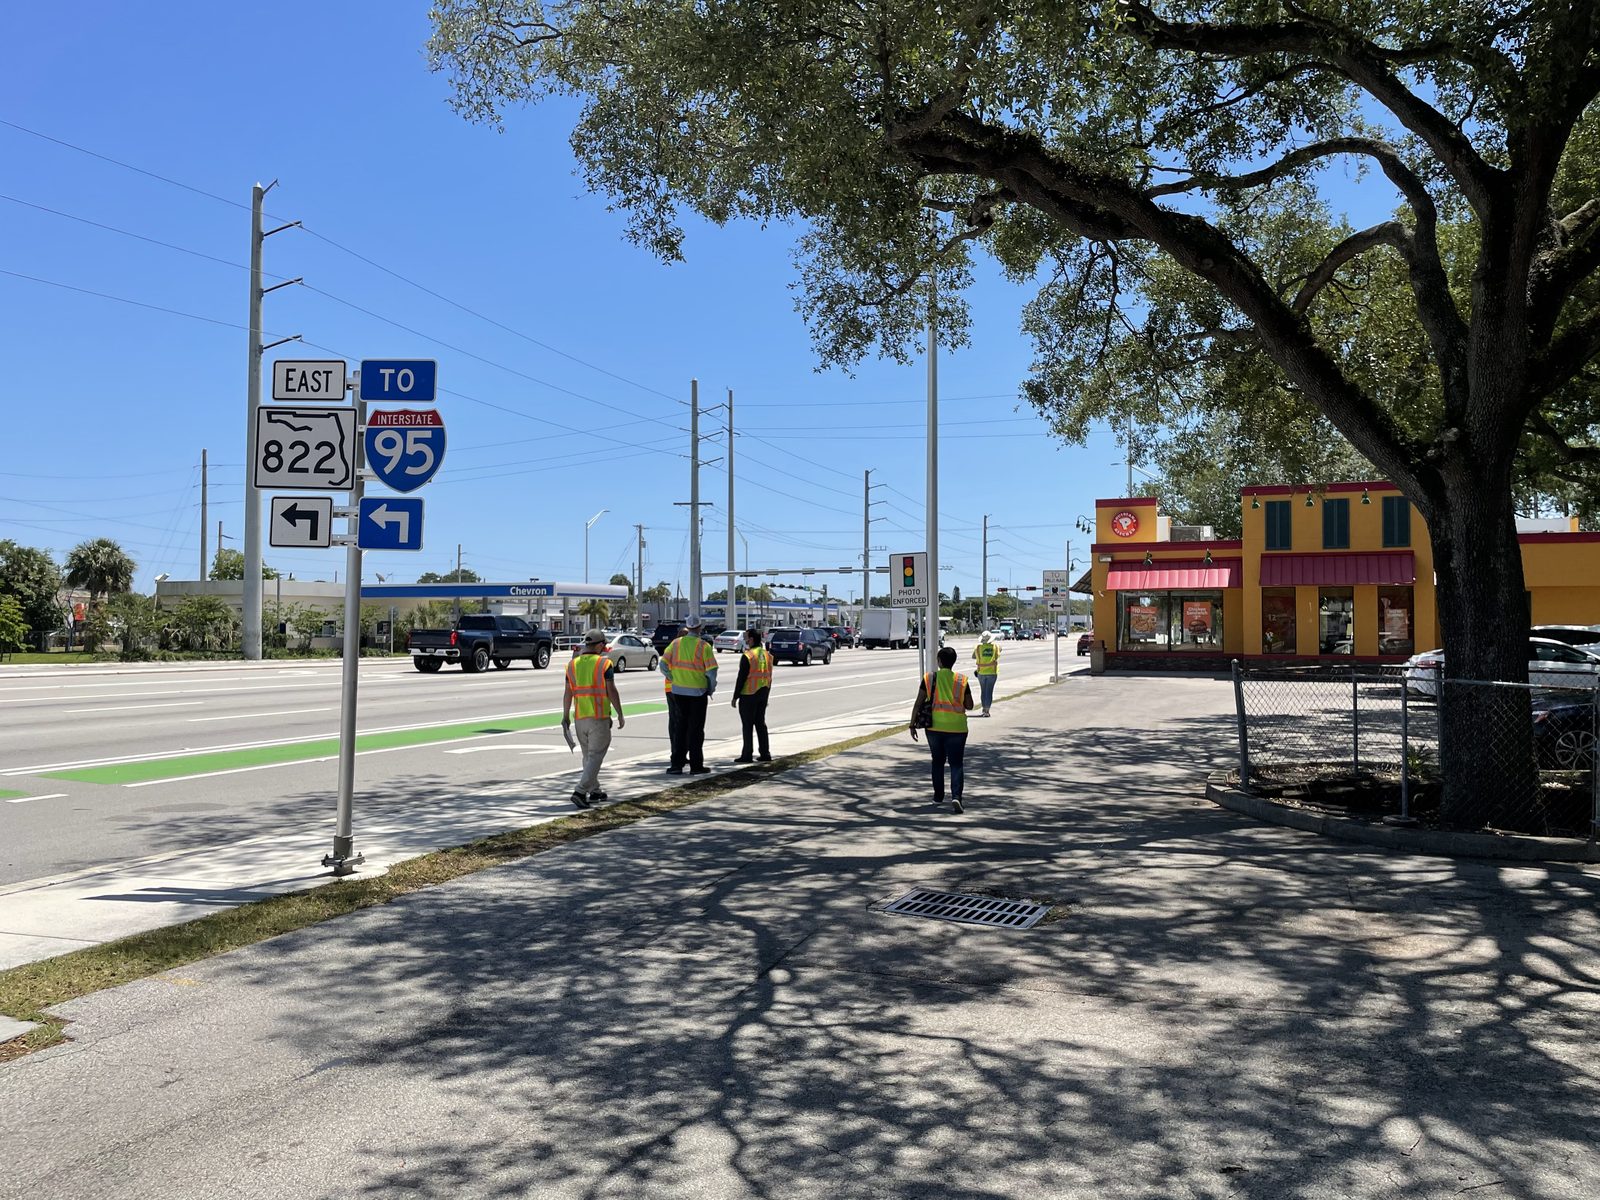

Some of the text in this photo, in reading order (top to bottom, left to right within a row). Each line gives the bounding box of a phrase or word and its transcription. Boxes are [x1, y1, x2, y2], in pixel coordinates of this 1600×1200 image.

[285, 368, 333, 393] EAST
[380, 368, 415, 393] TO
[377, 414, 433, 425] INTERSTATE
[262, 440, 336, 474] 822
[374, 429, 434, 476] 95
[510, 586, 547, 596] Chevron
[893, 597, 927, 605] ENFORCED
